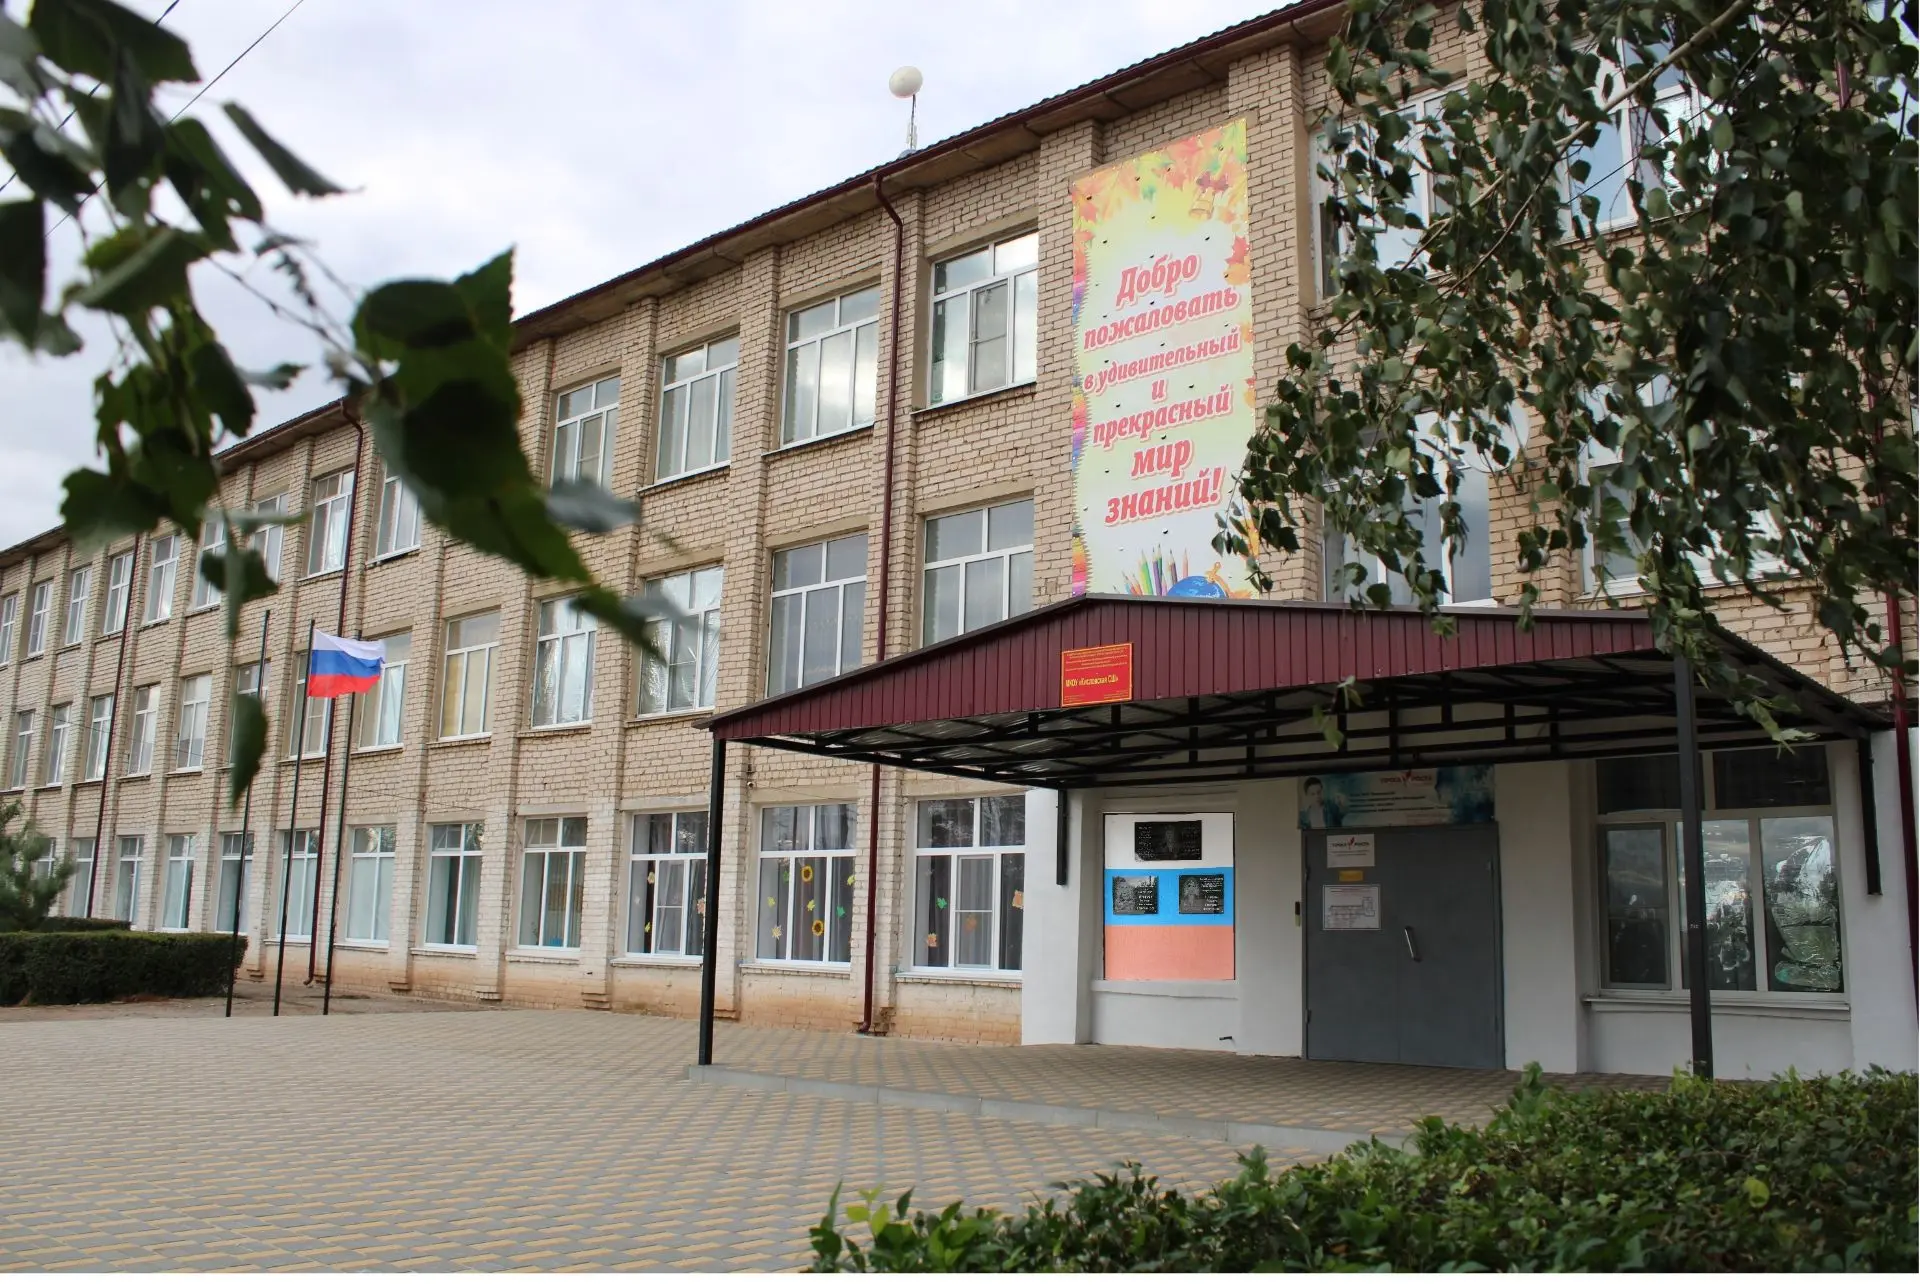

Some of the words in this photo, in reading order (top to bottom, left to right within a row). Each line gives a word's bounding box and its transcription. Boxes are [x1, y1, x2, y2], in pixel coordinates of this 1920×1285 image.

[1116, 254, 1198, 306] Добро
[1084, 287, 1238, 350] пожаловать
[1084, 374, 1094, 390] в
[1096, 327, 1239, 393] удивительный
[1093, 383, 1231, 448] прекрасный
[1151, 379, 1165, 400] и
[1131, 440, 1191, 478] мир
[1105, 467, 1222, 524] знаний!
